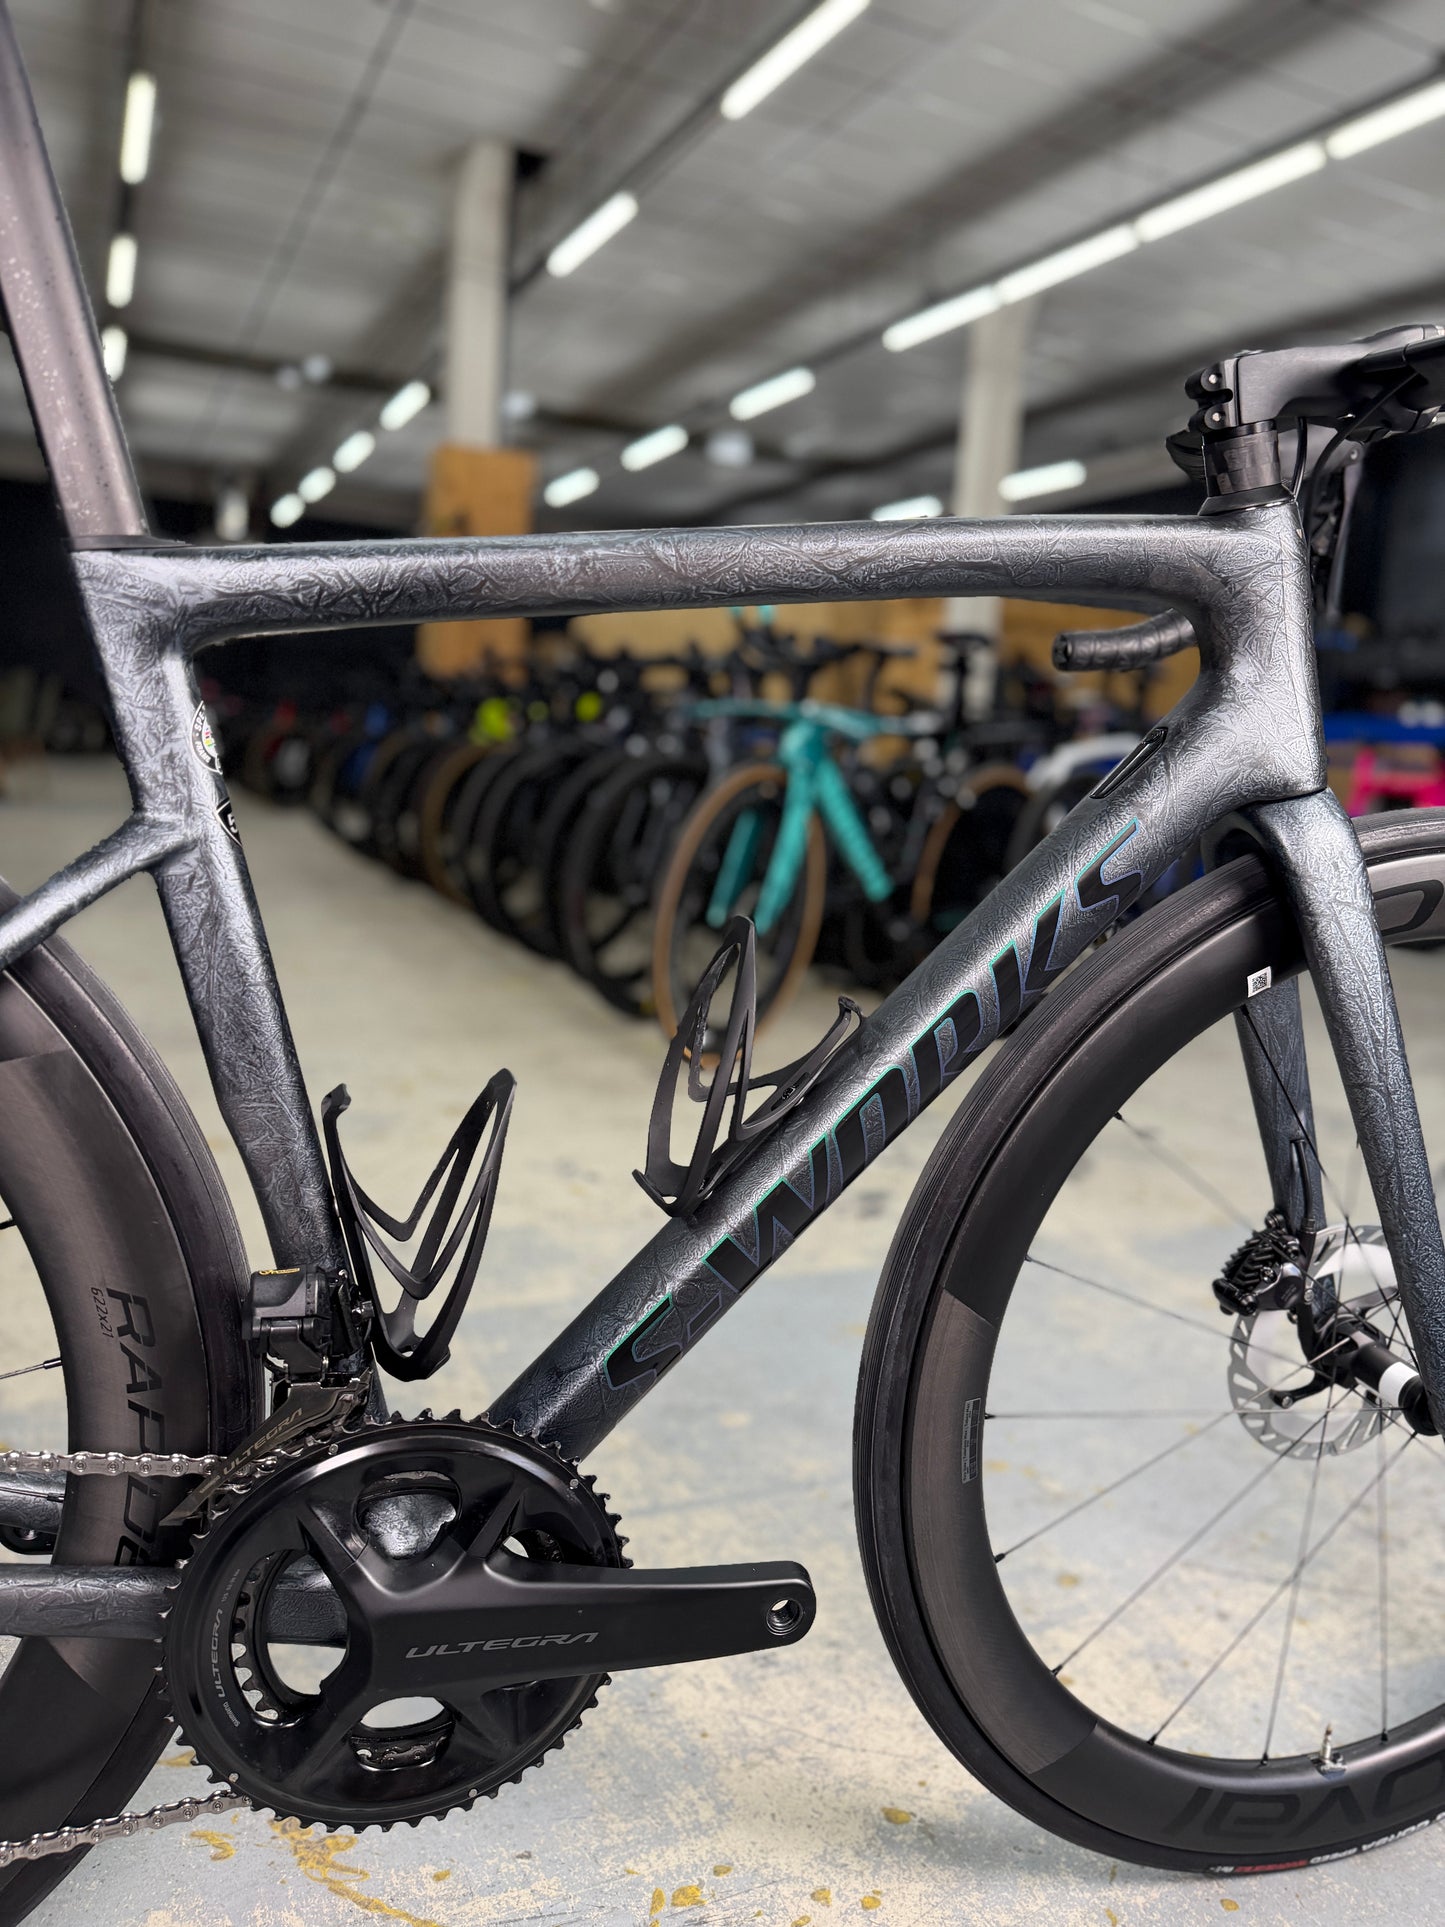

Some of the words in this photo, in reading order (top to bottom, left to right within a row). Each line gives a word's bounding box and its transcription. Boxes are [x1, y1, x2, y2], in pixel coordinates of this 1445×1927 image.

[90, 1286, 115, 1339] 622x21
[223, 1407, 304, 1476] ULTEGRA
[210, 1608, 226, 1698] ULTEGRA
[405, 1632, 600, 1659] ULTEGRA
